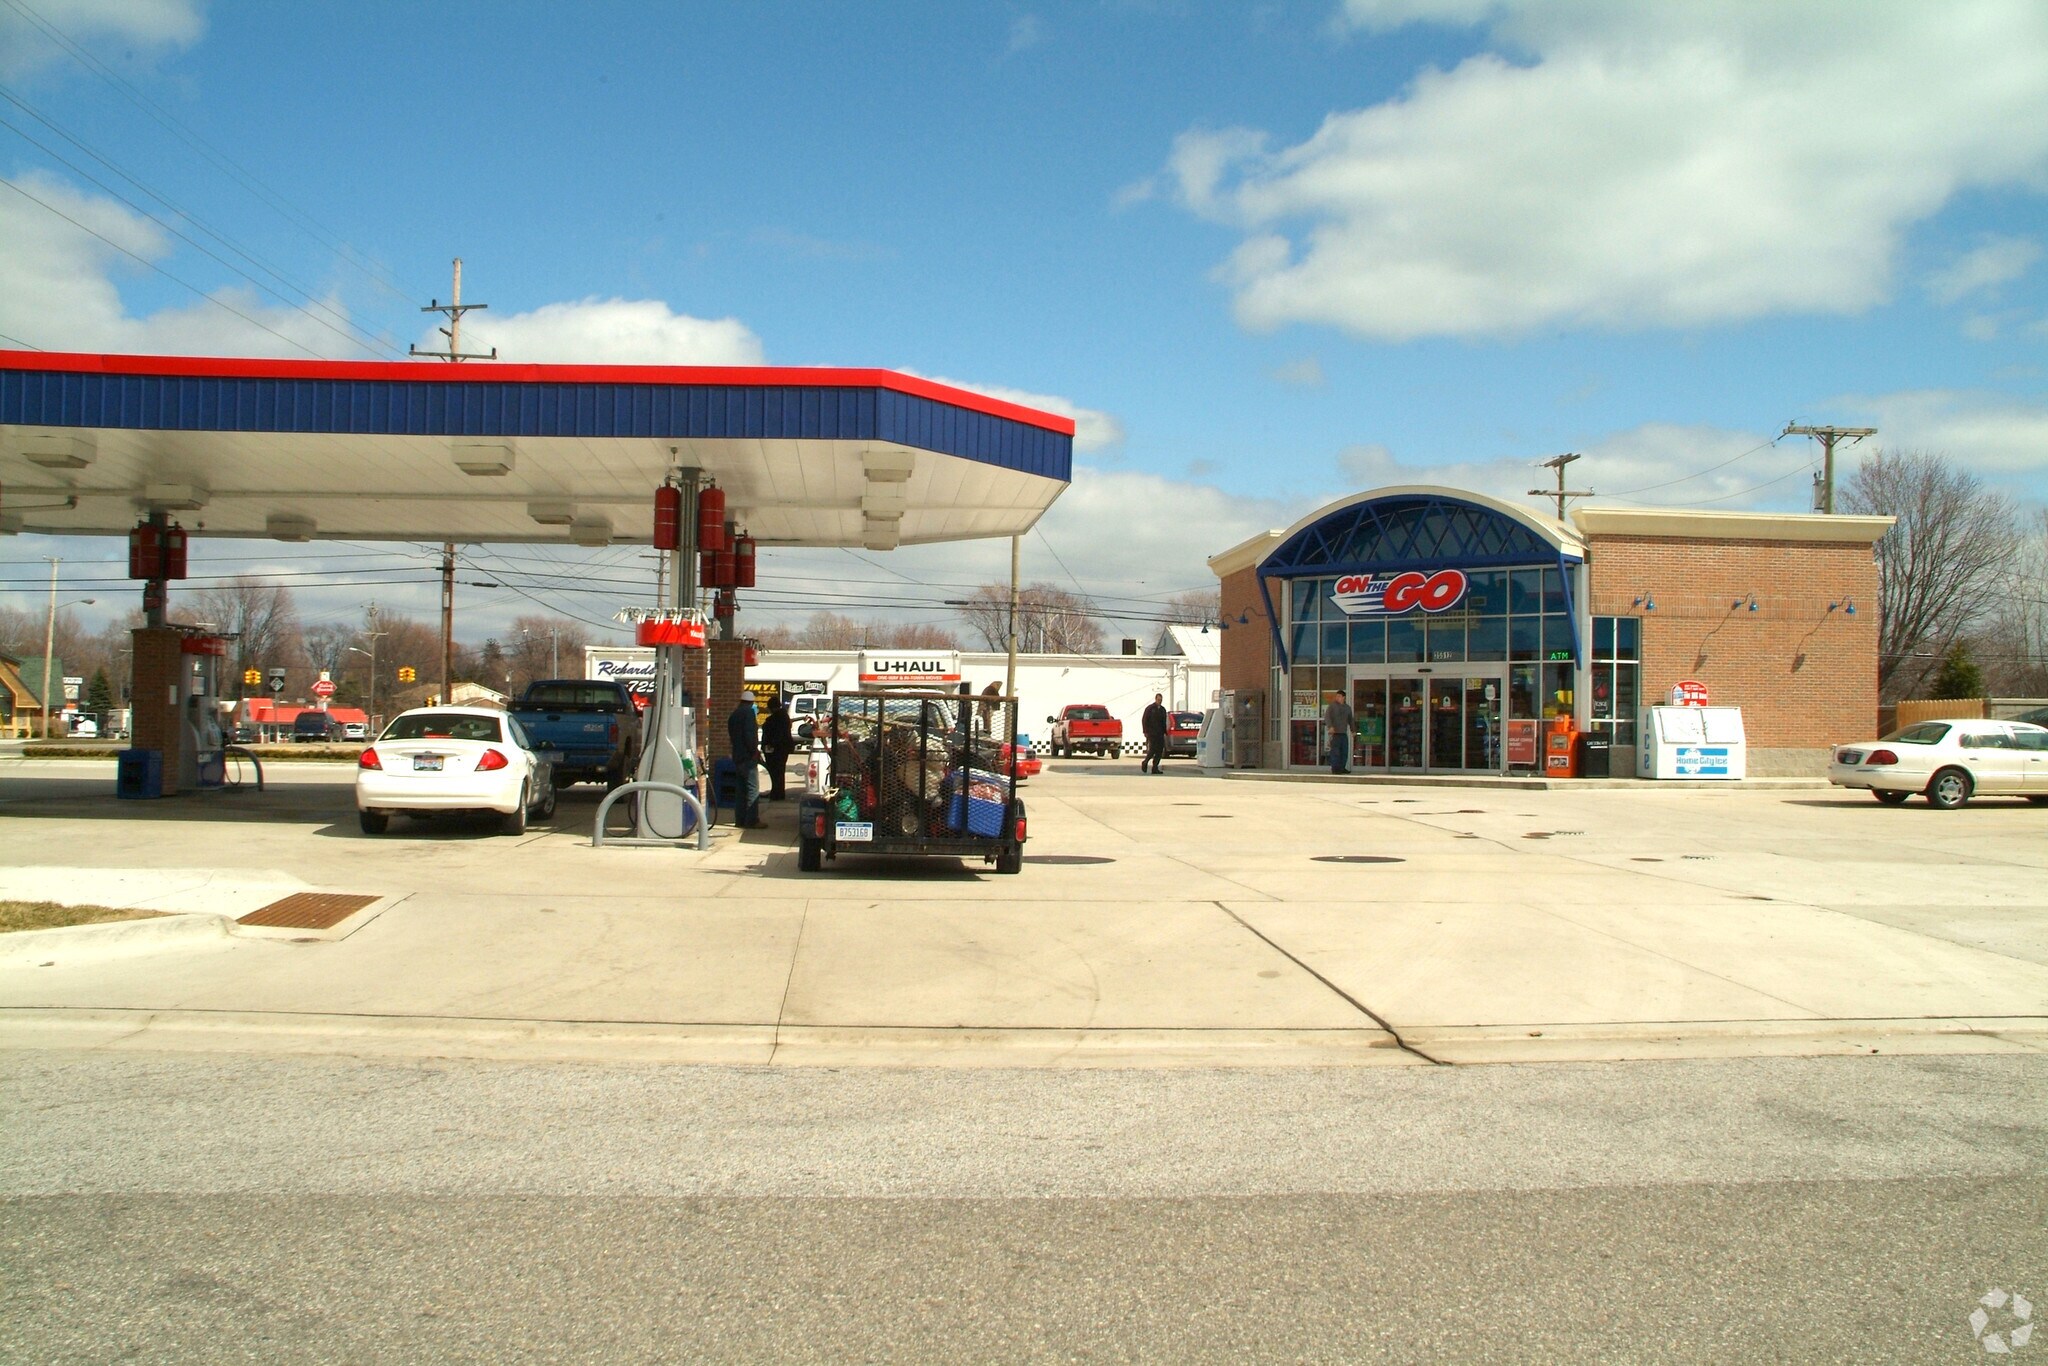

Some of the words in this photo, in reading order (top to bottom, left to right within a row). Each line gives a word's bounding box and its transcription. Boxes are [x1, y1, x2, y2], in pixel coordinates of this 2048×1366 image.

[1336, 575, 1370, 594] ON
[1366, 582, 1388, 592] THE
[1382, 569, 1464, 612] GO
[1551, 652, 1568, 660] ATM
[874, 661, 946, 672] U-HAUL
[1676, 757, 1699, 765] Home
[1700, 757, 1715, 766] City
[1715, 757, 1728, 765] Ice
